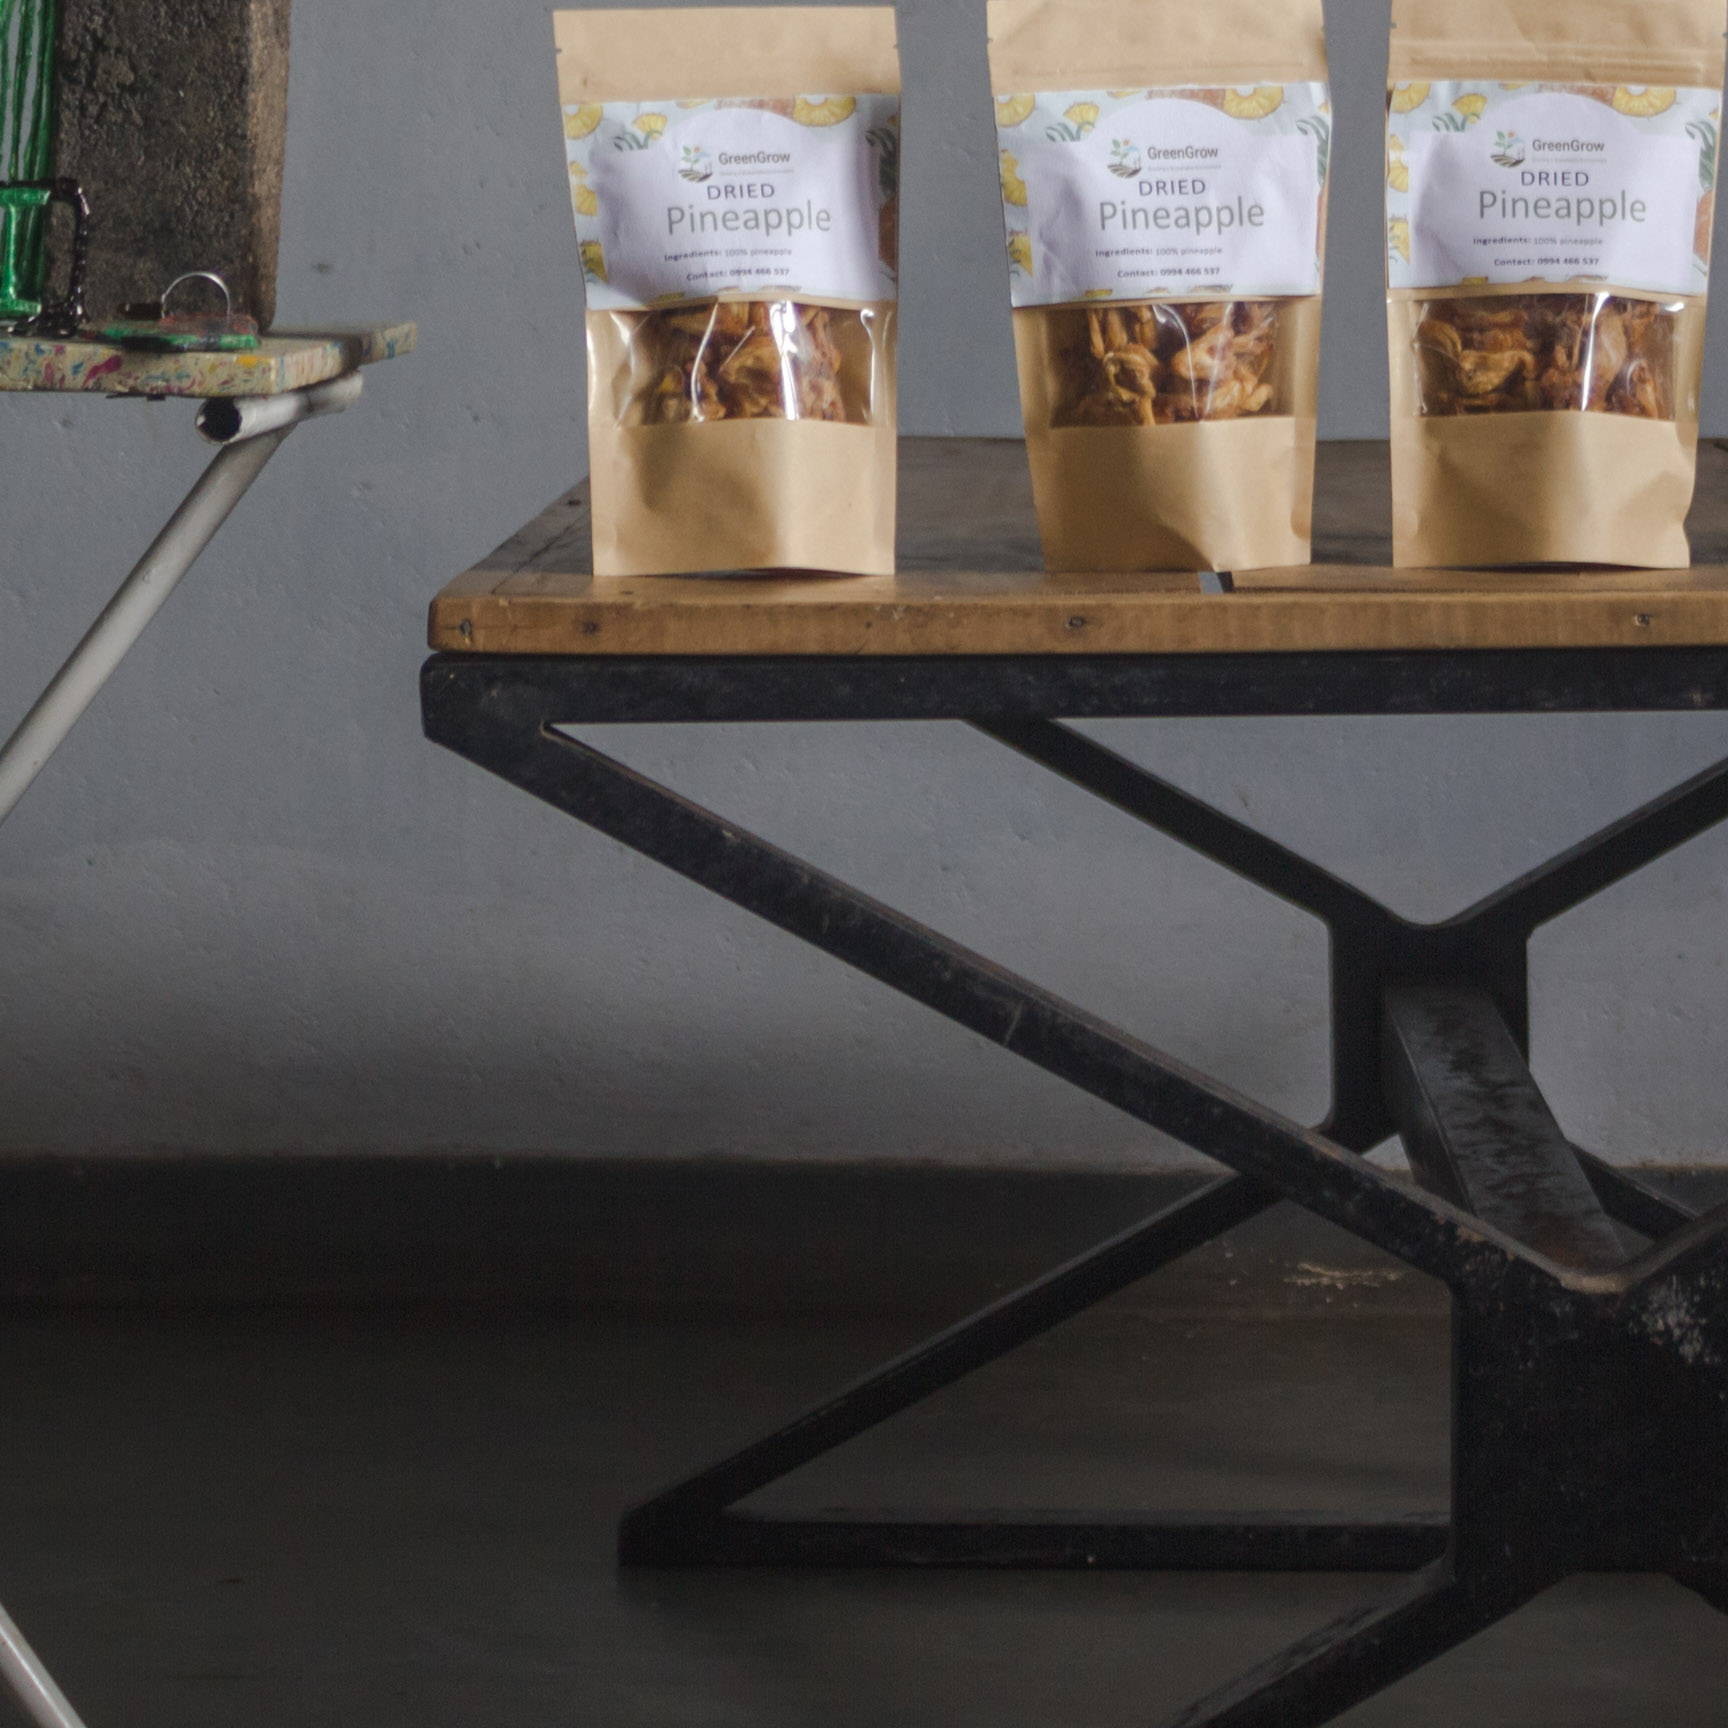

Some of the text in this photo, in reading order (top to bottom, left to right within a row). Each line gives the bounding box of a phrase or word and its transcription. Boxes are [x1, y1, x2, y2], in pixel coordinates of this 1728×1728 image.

[1147, 145, 1218, 160] GreenGrow
[1532, 139, 1605, 152] GreenGrow
[718, 151, 791, 166] GreenGrow
[1521, 171, 1589, 187] DRIED
[706, 183, 776, 200] DRIED
[1138, 178, 1206, 197] DRIED
[1099, 195, 1265, 236] Pineapple
[1479, 189, 1647, 227] Pineapple
[666, 199, 831, 237] Pineapple
[1473, 236, 1603, 248] Ingredients: 100% pineapple
[664, 248, 792, 262] Ingredients: 100% pineapple
[1095, 247, 1222, 258] Ingredients: 100% pineapple
[1494, 258, 1535, 267] Contact:
[686, 269, 729, 282] Contact:
[1117, 269, 1158, 279] Contact:
